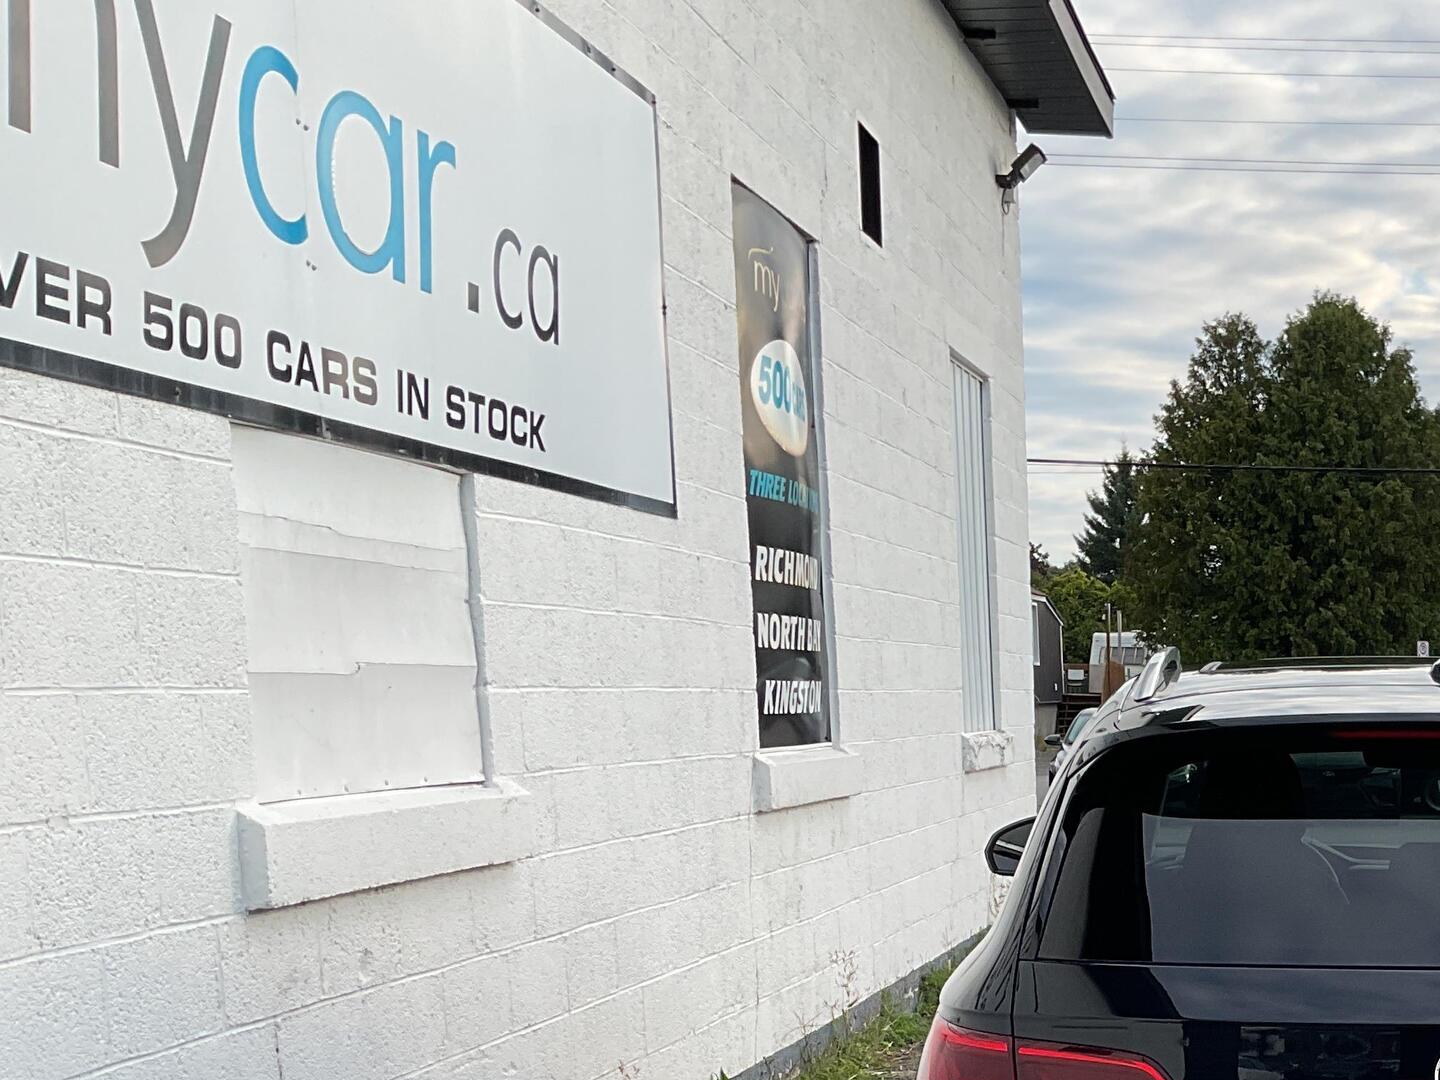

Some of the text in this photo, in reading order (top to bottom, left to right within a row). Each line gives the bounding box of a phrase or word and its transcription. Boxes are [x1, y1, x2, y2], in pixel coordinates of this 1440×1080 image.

[753, 260, 780, 312] my
[142, 290, 242, 369] 500
[266, 329, 378, 406] CARS
[397, 368, 430, 431] IN
[445, 384, 547, 453] STOCK
[749, 468, 786, 503] THREE
[756, 612, 821, 652] NORTH BAY
[763, 679, 822, 715] KINGSTON
